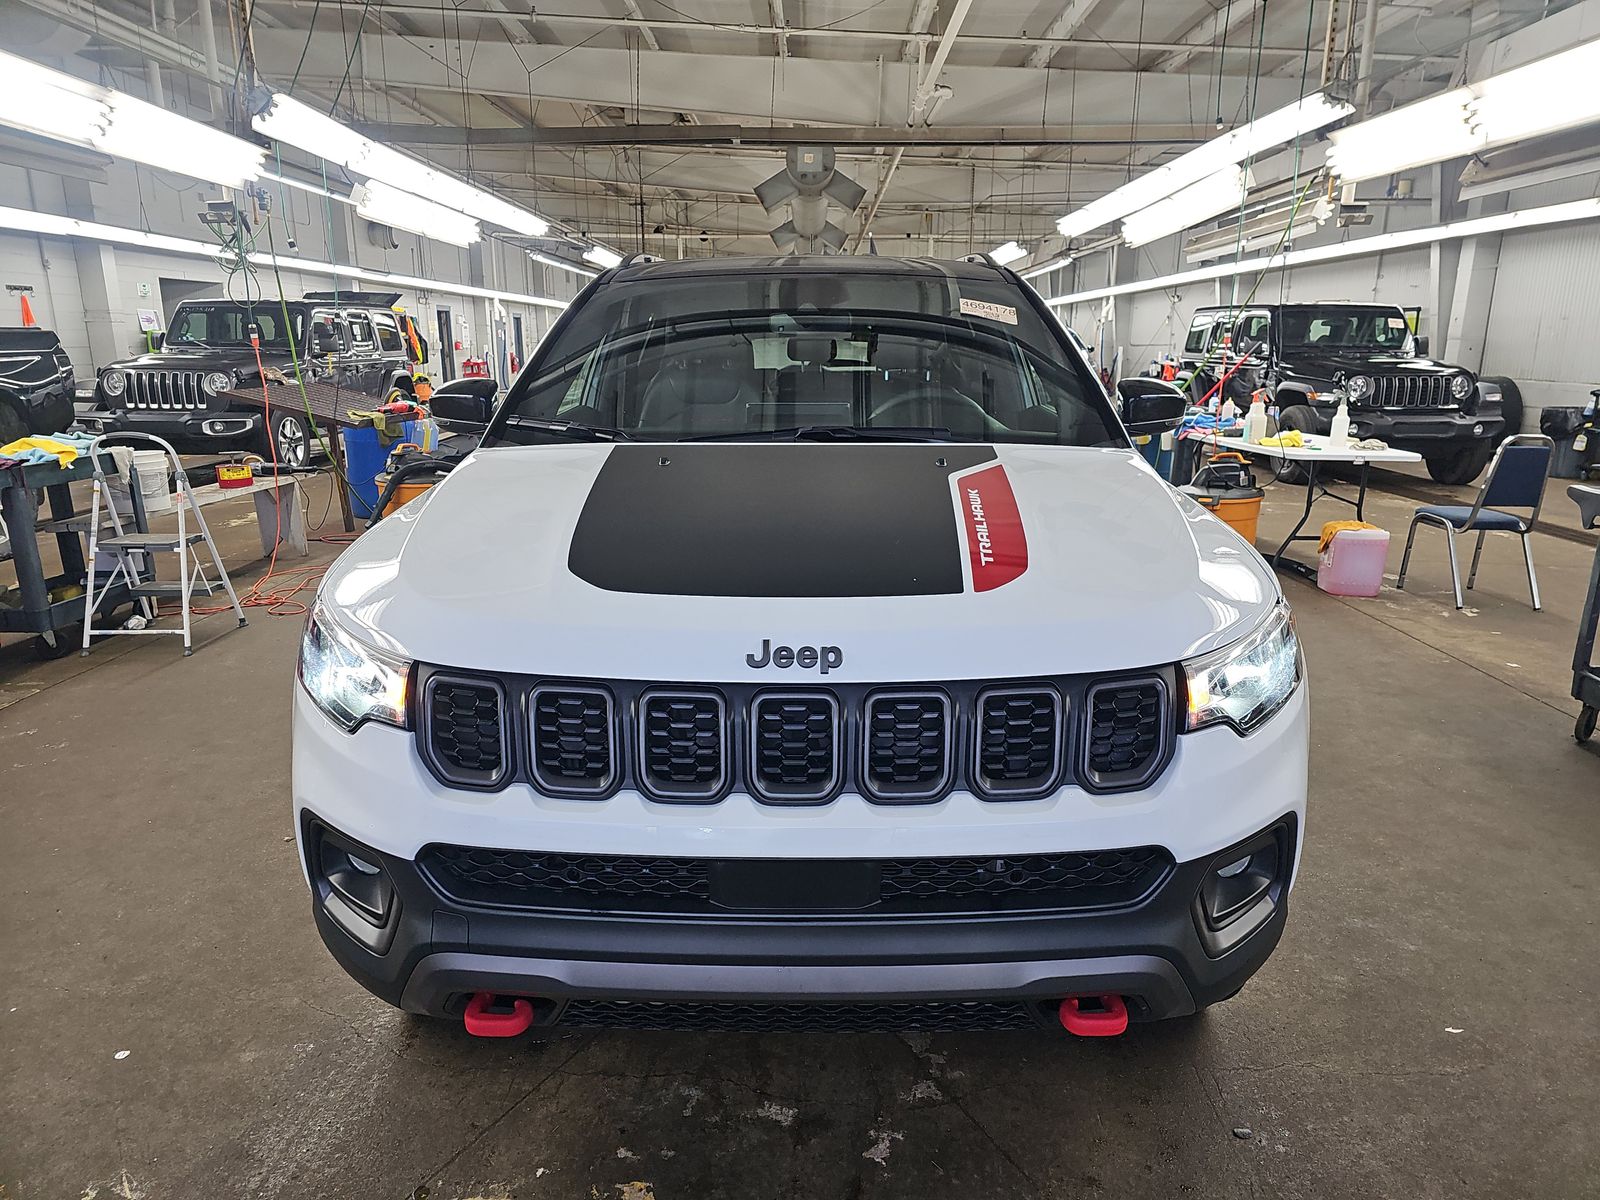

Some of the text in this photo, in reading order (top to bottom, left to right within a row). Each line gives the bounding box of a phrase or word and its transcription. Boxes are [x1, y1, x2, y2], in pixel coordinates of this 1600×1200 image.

[962, 301, 1016, 316] 4694178
[967, 488, 994, 567] TRAILHAWK
[745, 638, 844, 675] Jeep
